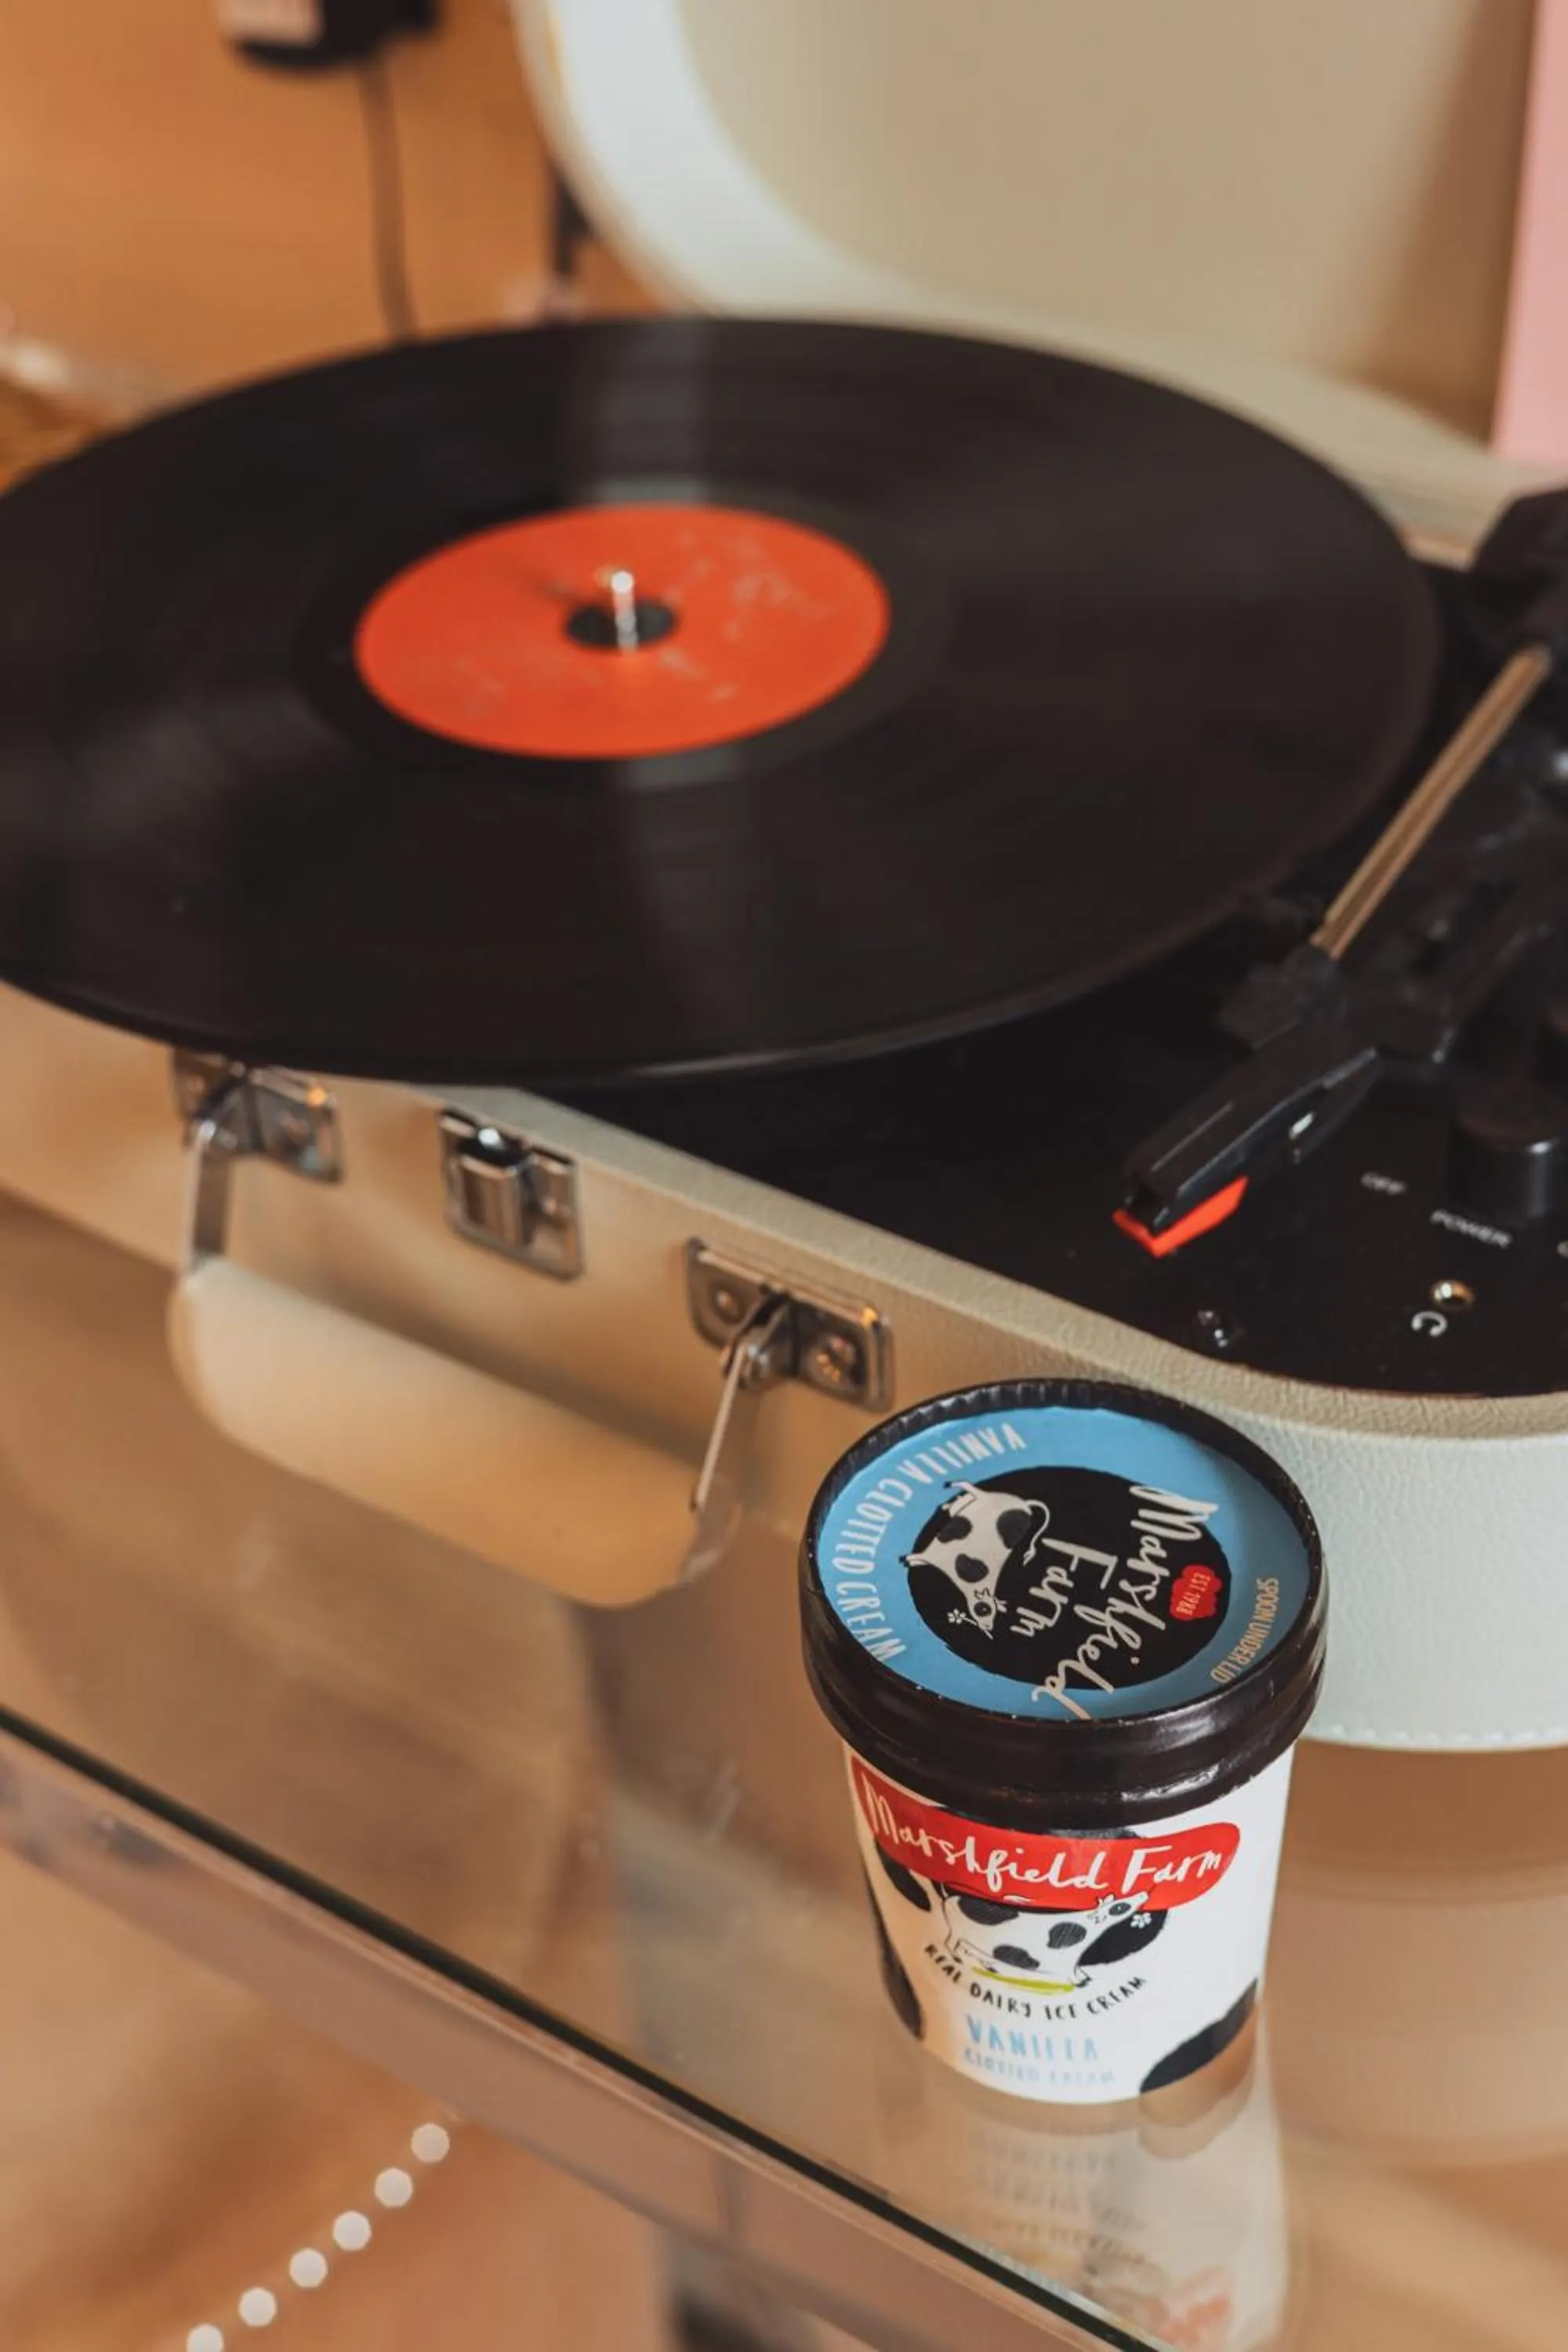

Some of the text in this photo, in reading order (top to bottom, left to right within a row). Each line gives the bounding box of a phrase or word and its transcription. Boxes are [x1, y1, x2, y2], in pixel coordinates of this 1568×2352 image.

[1430, 1210, 1512, 1248] POWER
[832, 1423, 1027, 1662] VANILLA CLOTTED CREAM
[1011, 1537, 1119, 1637] Farm
[1031, 1485, 1219, 1720] Marshfield
[1210, 1577, 1279, 1684] SPOON UNDER LID
[862, 1770, 1221, 1893] Marshfield Farm
[924, 1944, 1148, 2020] REAL DAIRY ICE CREAM
[966, 2013, 1098, 2061] VANILLA
